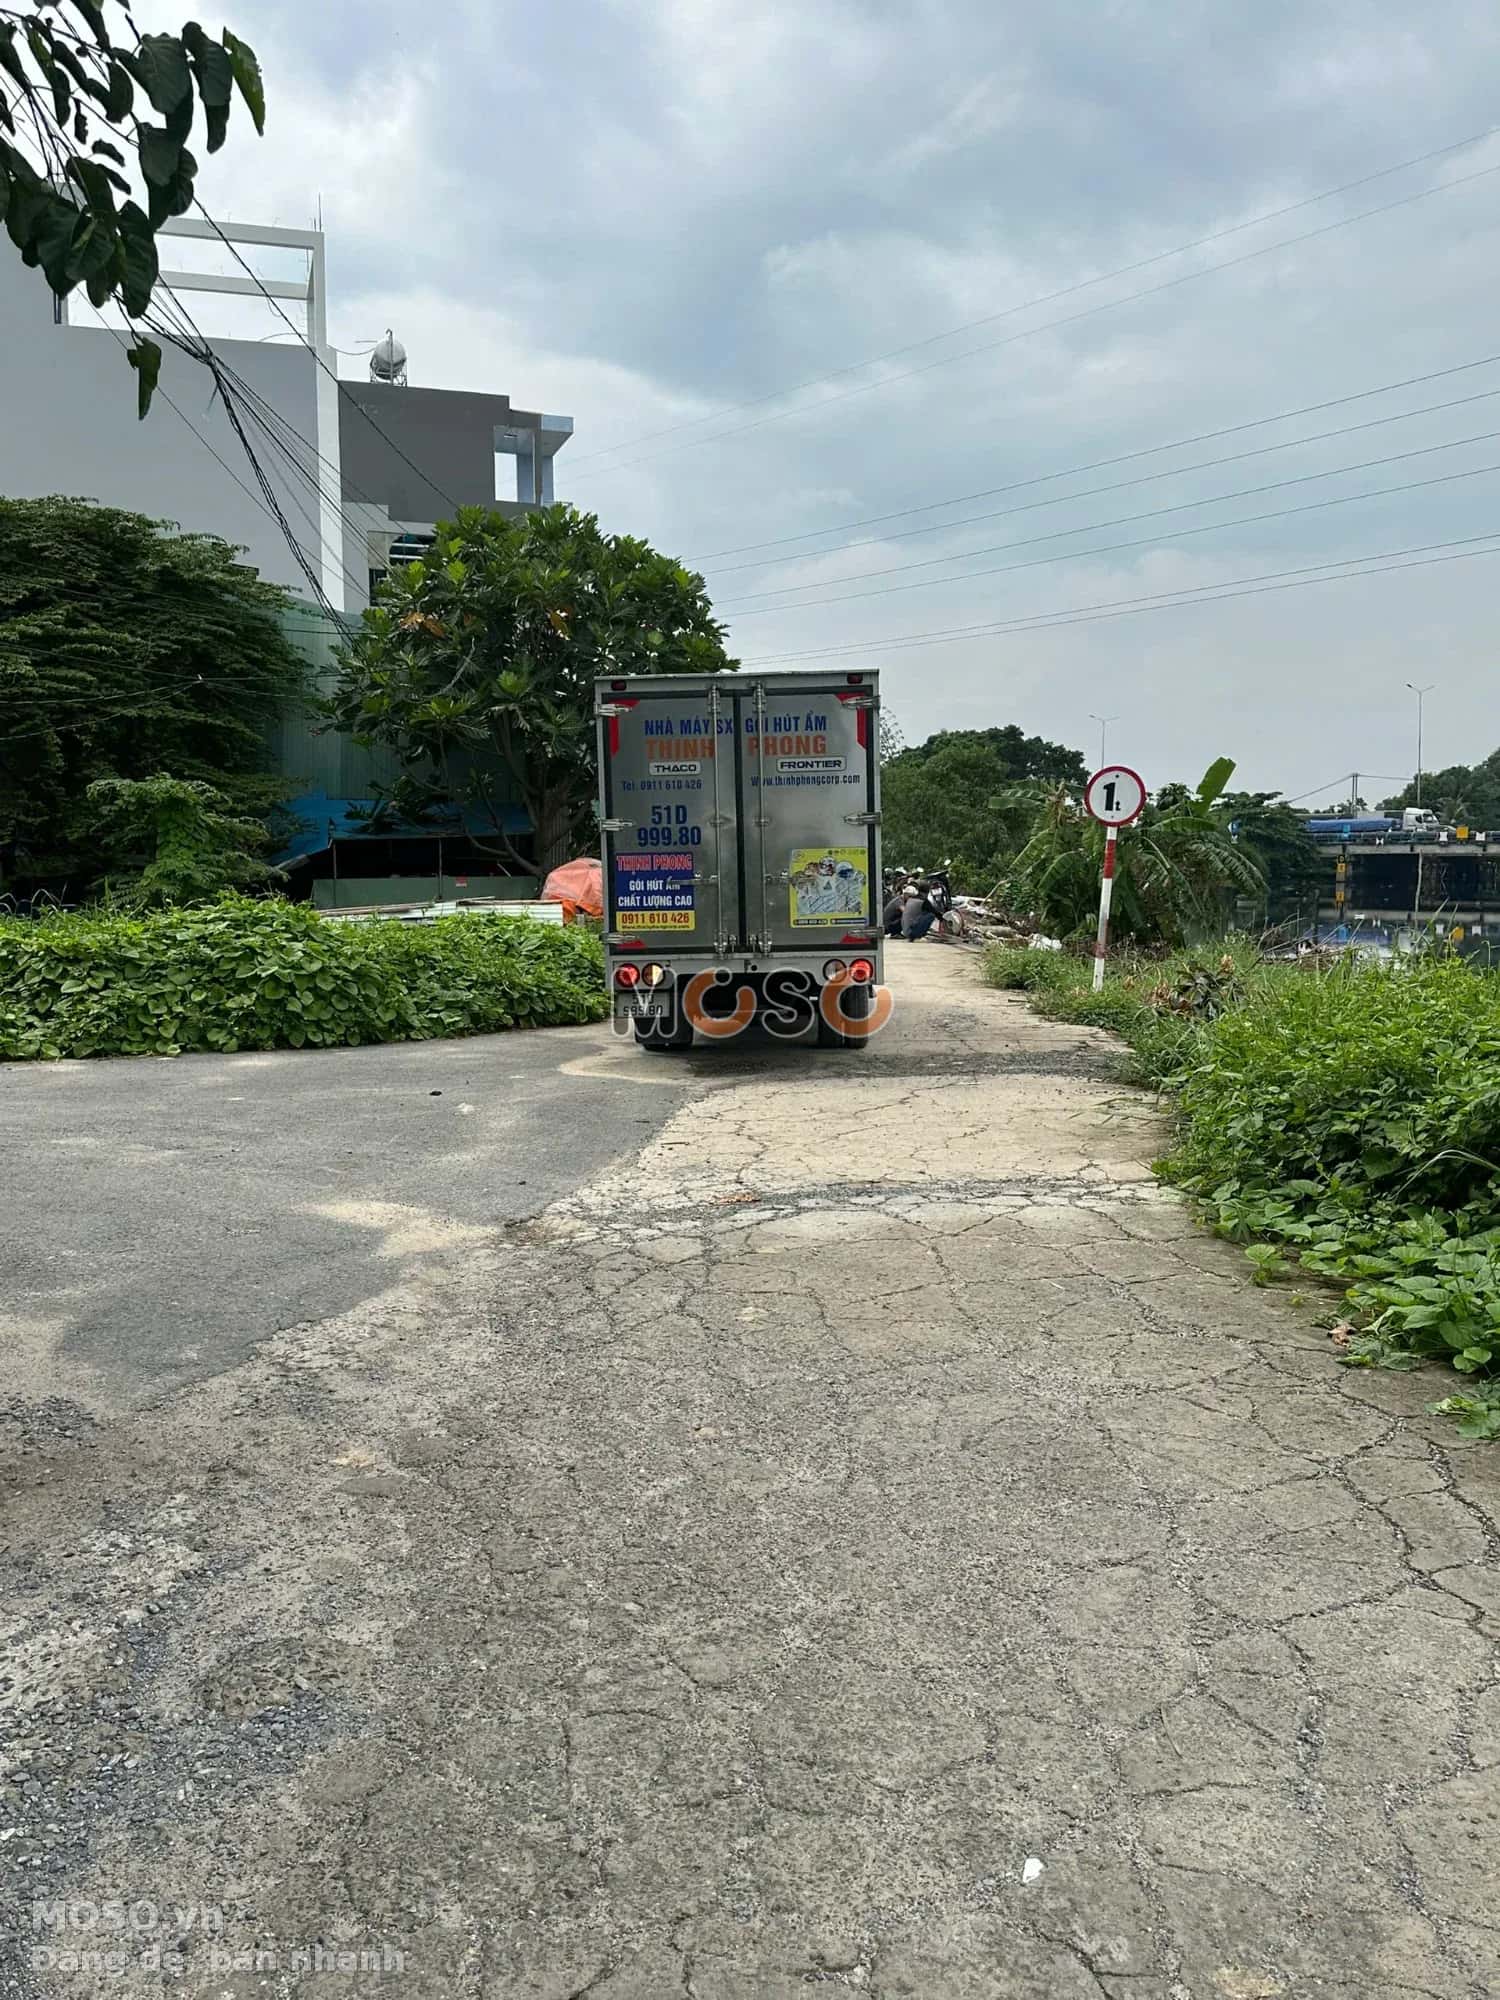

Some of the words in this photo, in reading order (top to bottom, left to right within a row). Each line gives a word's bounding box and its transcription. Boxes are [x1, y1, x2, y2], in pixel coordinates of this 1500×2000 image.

[680, 715, 710, 735] MÁY
[716, 718, 734, 735] SX
[774, 713, 801, 733] HÚT
[747, 734, 827, 757] PHONG
[654, 764, 697, 773] THACO
[780, 759, 842, 770] FRONTIER
[651, 805, 687, 826] 51D
[637, 825, 702, 847] 999.80
[616, 854, 651, 874] THỊNH
[653, 853, 692, 871] PHONG
[646, 877, 664, 891] HÚT
[617, 893, 641, 907] CHẤT
[643, 895, 673, 909] LƯỢNG
[674, 895, 692, 906] CAO
[621, 913, 645, 924] 0911
[649, 913, 668, 924] 610
[671, 912, 690, 924] 426
